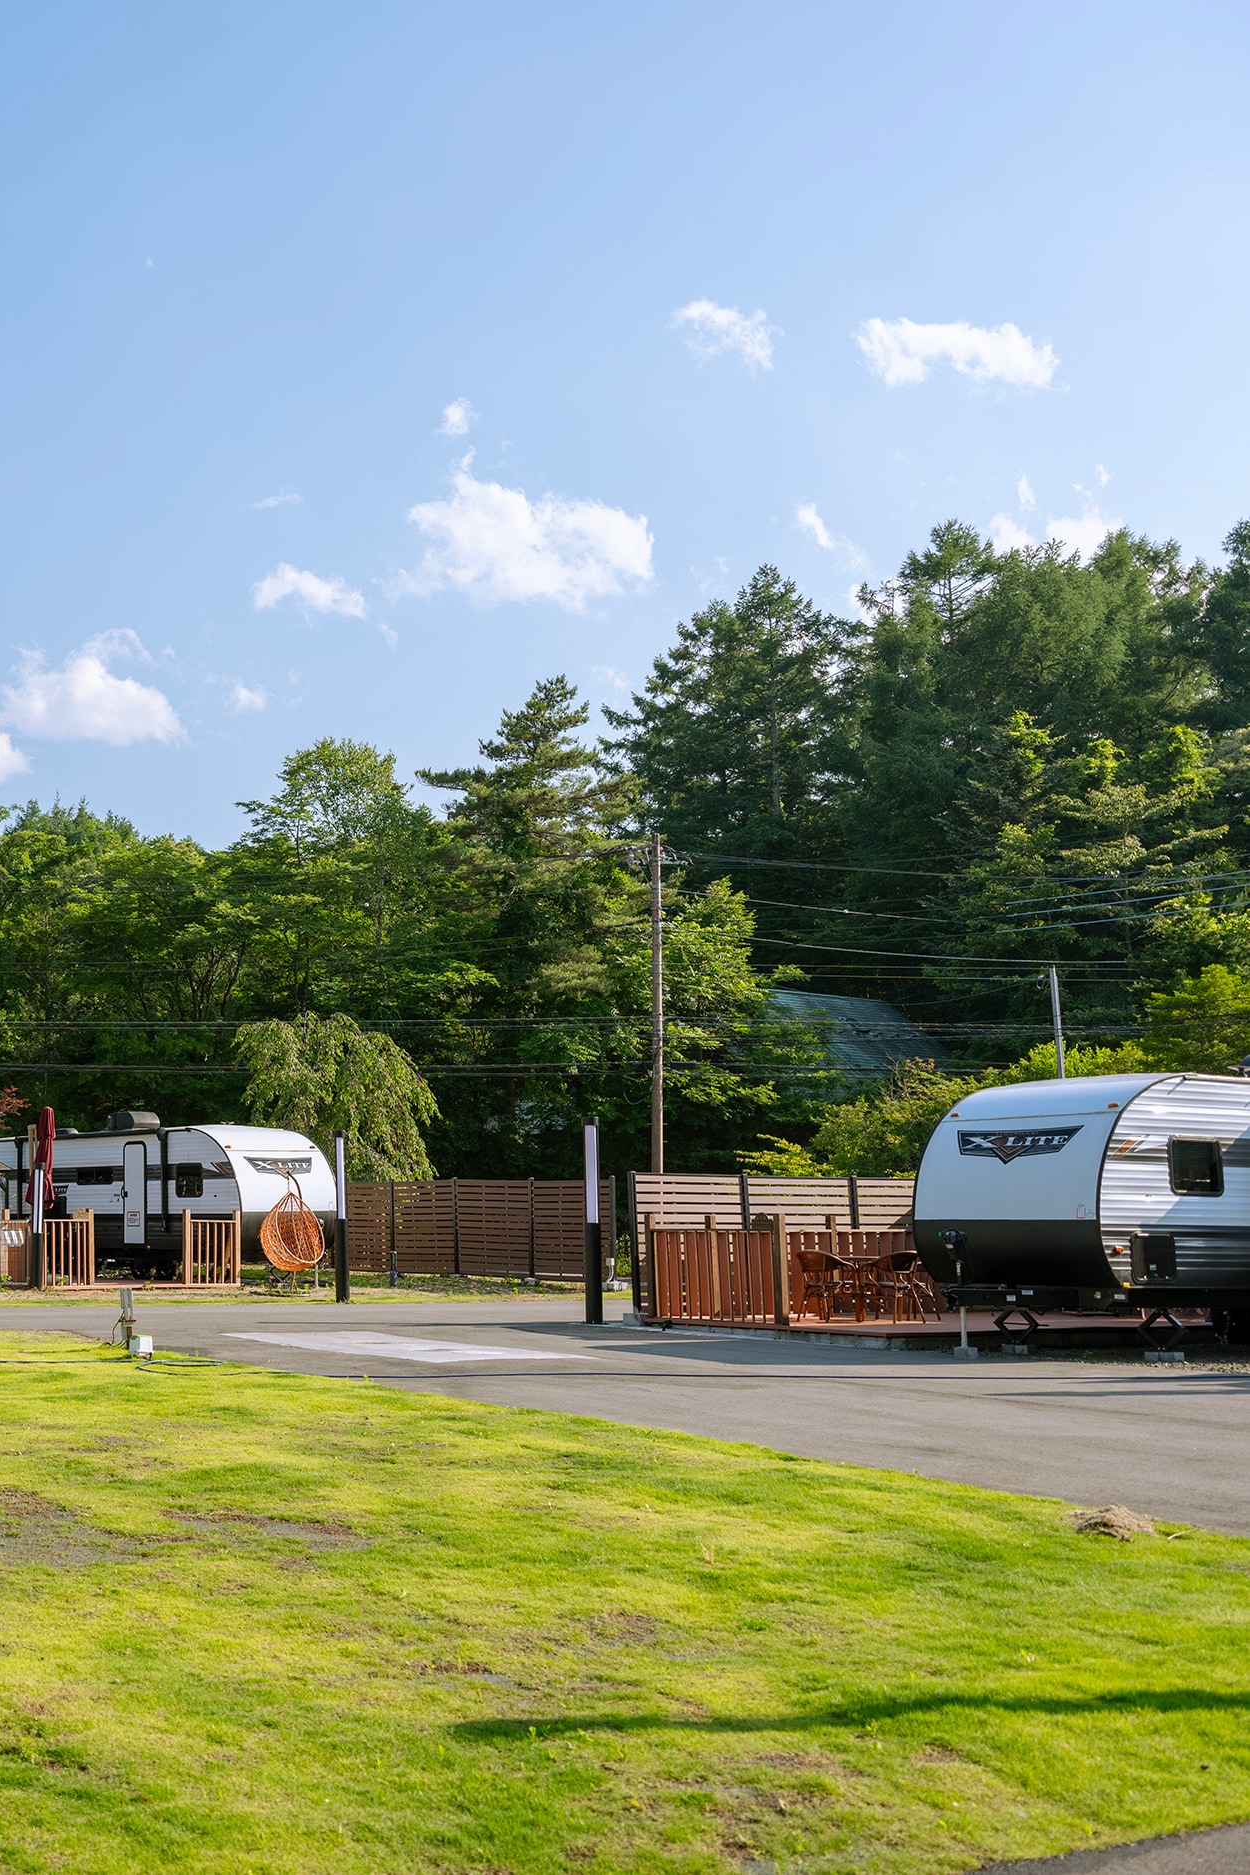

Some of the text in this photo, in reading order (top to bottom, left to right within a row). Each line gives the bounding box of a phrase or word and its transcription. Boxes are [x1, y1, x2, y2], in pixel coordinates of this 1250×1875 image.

[961, 1135, 1069, 1149] X LITE
[251, 1160, 274, 1169] X
